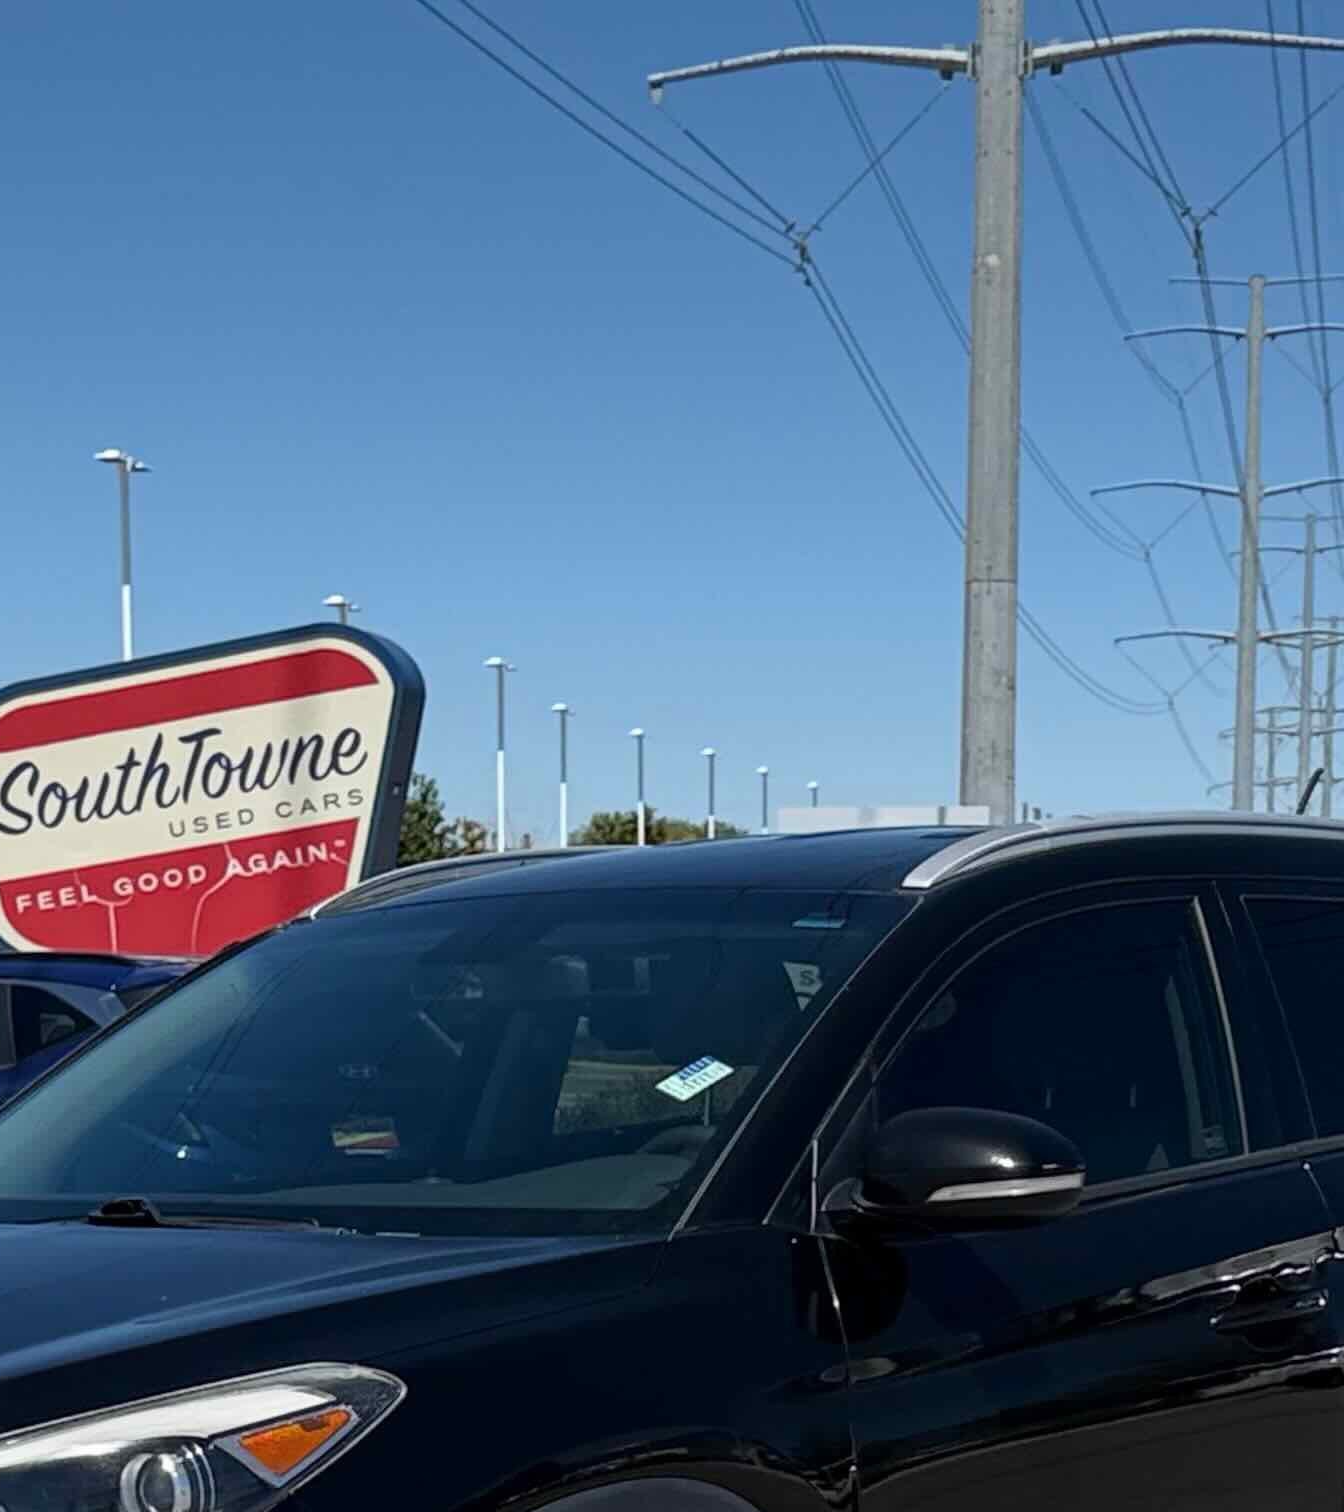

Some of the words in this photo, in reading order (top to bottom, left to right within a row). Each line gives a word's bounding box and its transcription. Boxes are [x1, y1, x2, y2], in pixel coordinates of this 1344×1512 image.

[169, 808, 255, 838] USED
[274, 788, 365, 819] CARS
[15, 884, 97, 914] FEEL
[112, 863, 207, 897] GOOD
